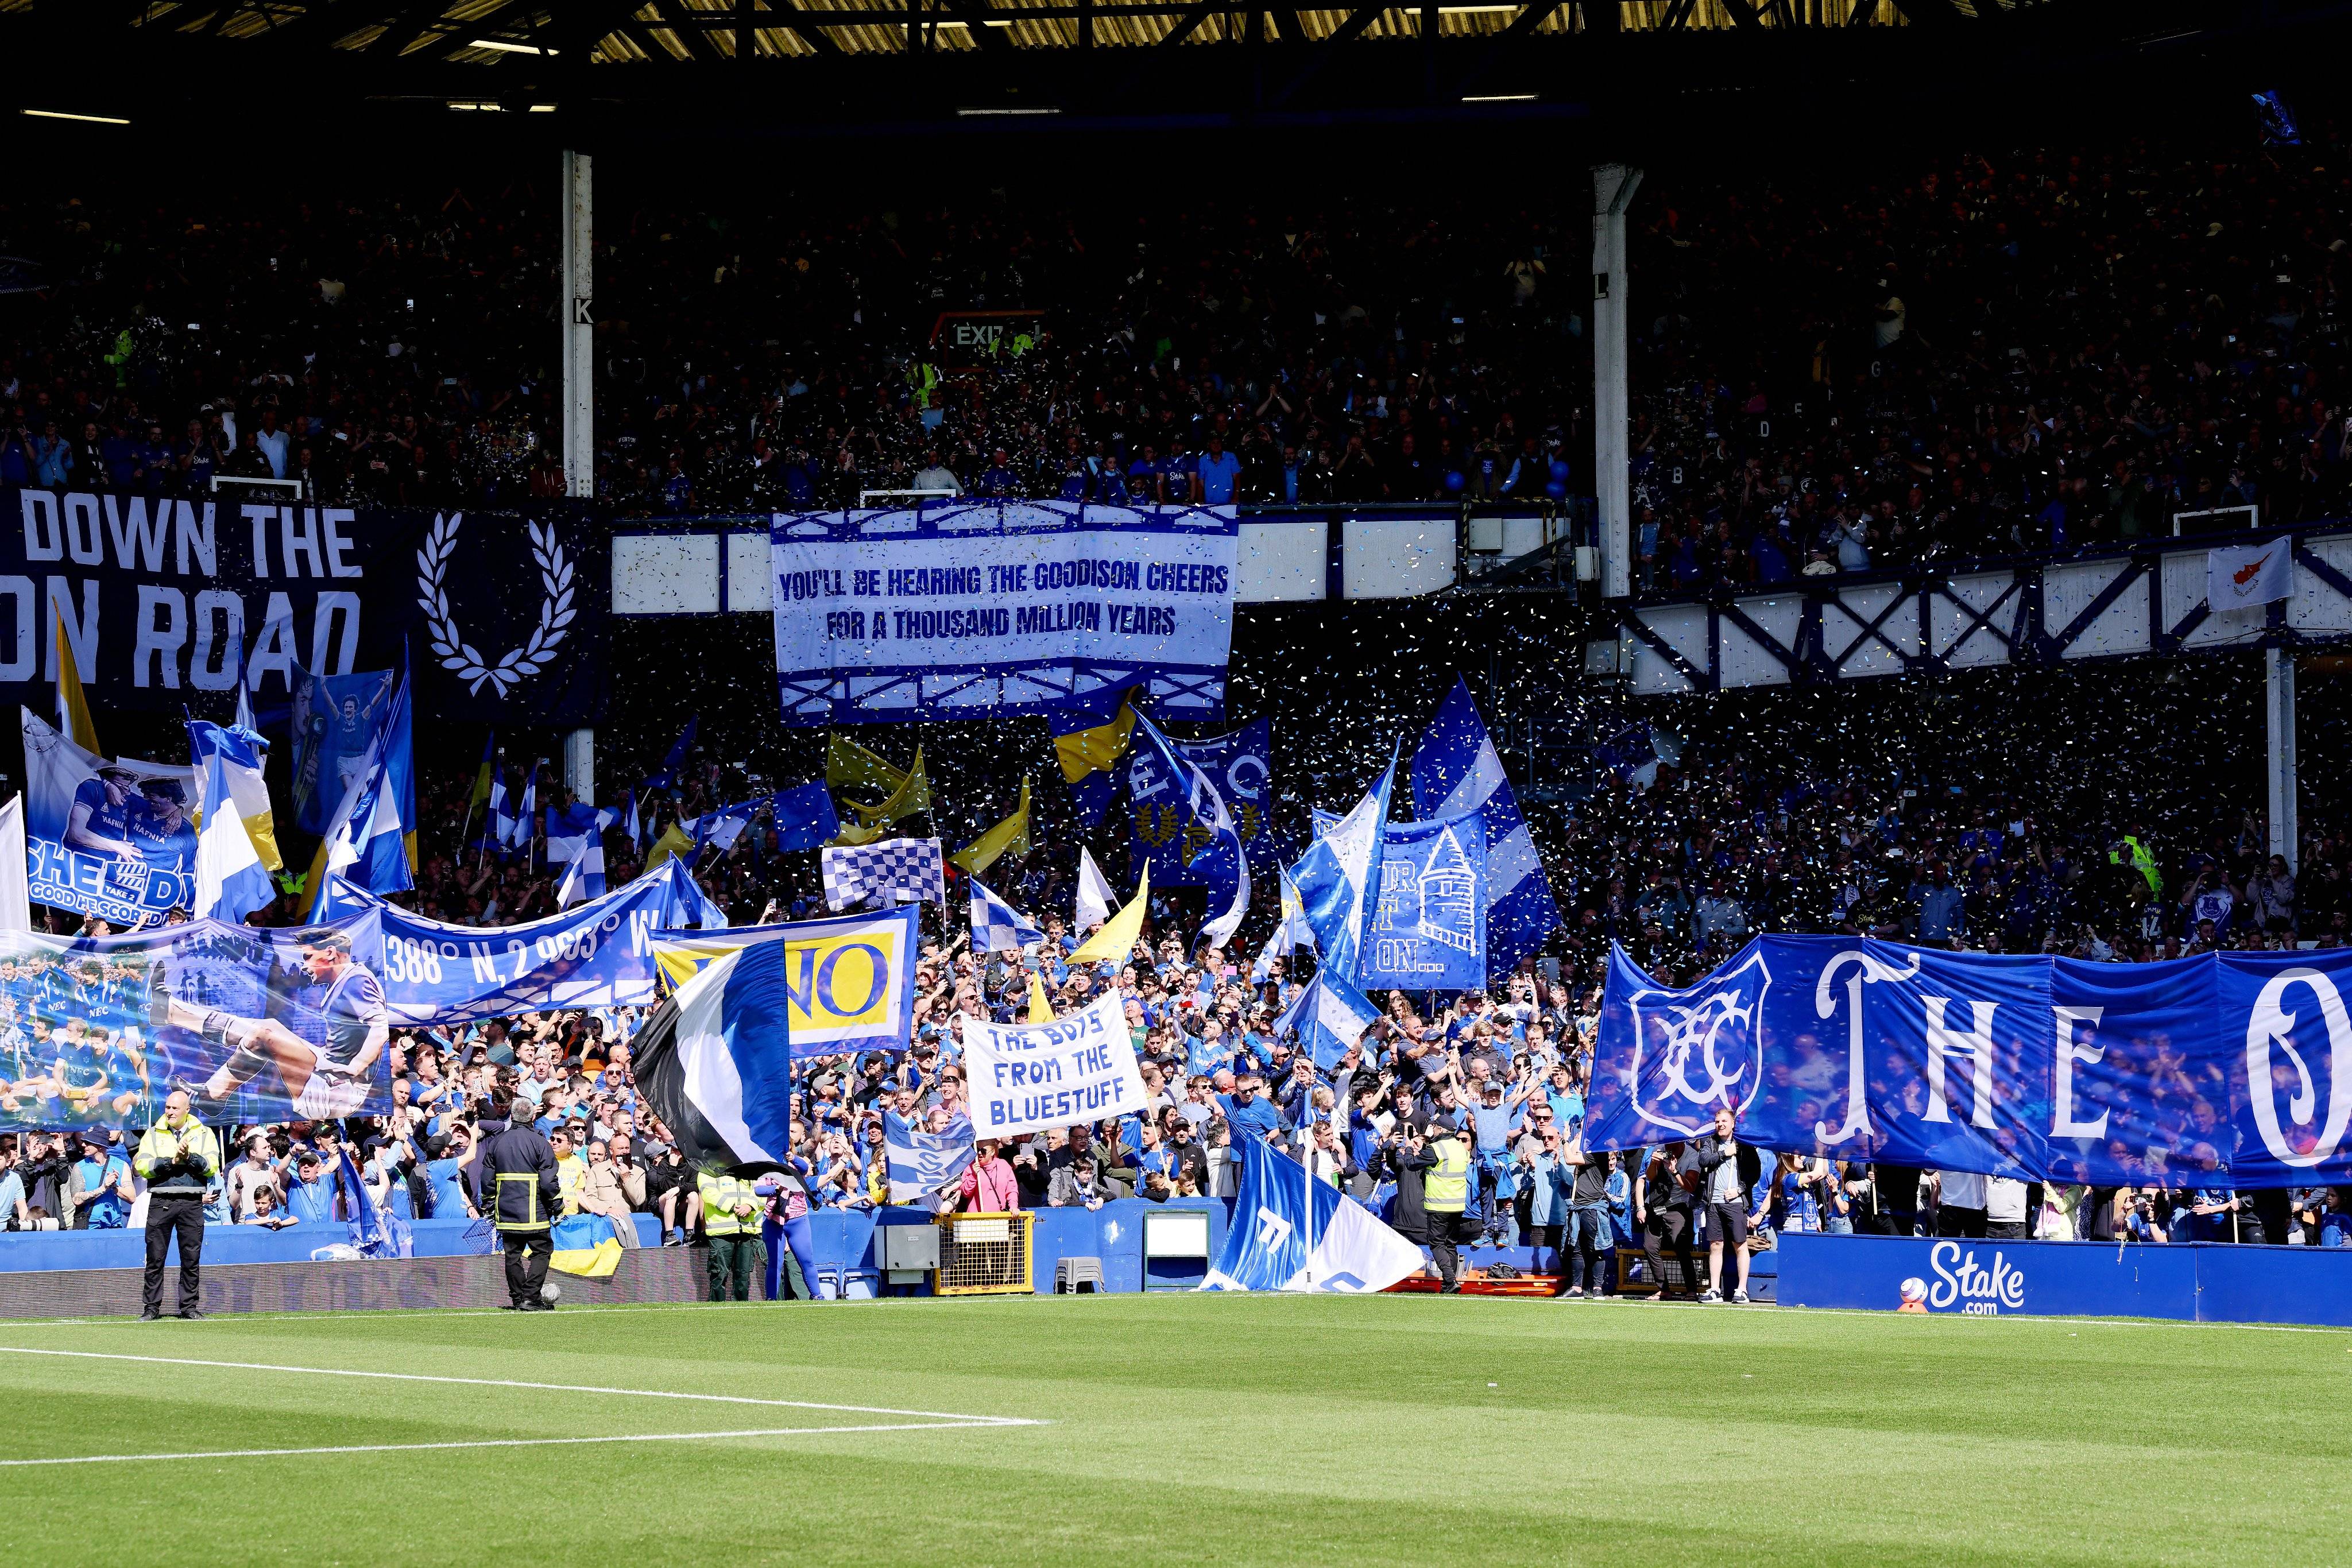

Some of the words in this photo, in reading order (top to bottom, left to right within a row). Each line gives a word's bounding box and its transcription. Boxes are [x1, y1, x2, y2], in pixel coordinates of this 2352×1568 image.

[1595, 275, 1606, 298] L
[576, 300, 593, 323] K
[1871, 361, 1881, 378] G
[1761, 420, 1770, 438] D
[194, 455, 209, 464] Stake
[1170, 472, 1185, 482] Stake
[1673, 466, 1682, 484] B
[1636, 486, 1650, 503] A
[20, 489, 218, 576] DOWN
[241, 504, 363, 578] THE
[780, 570, 846, 601] YOU'LL
[853, 569, 881, 597] BE
[888, 567, 982, 596] HEARING
[988, 564, 1028, 592] THE
[1034, 559, 1139, 590] GOODISON
[1146, 561, 1228, 594] CHEERS
[827, 611, 865, 641] FOR
[872, 610, 888, 640] A
[893, 607, 1010, 640] THOUSAND
[1016, 601, 1101, 634] MILLION
[1108, 603, 1175, 637] YEARS
[133, 584, 361, 691] ROAD
[102, 815, 124, 830] HAFNIA
[133, 822, 165, 845] HAFNIA
[106, 885, 127, 899] TAKE
[30, 882, 76, 907] GOOD
[76, 896, 98, 913] HE
[98, 900, 163, 926] SCORD
[2141, 916, 2163, 938] 14
[468, 941, 506, 988] N,
[629, 909, 660, 958] W
[48, 1001, 66, 1012] NEC
[89, 1005, 109, 1018] NEC
[988, 1028, 1036, 1051] THE
[1042, 1009, 1104, 1046] BOYS
[1815, 950, 2111, 1145] THE
[994, 1058, 1062, 1087] FROM
[1071, 1043, 1113, 1076] THE
[990, 1077, 1125, 1125] BLUESTUFF
[1930, 1241, 2024, 1308] Stake
[1961, 1300, 1997, 1315] .com
